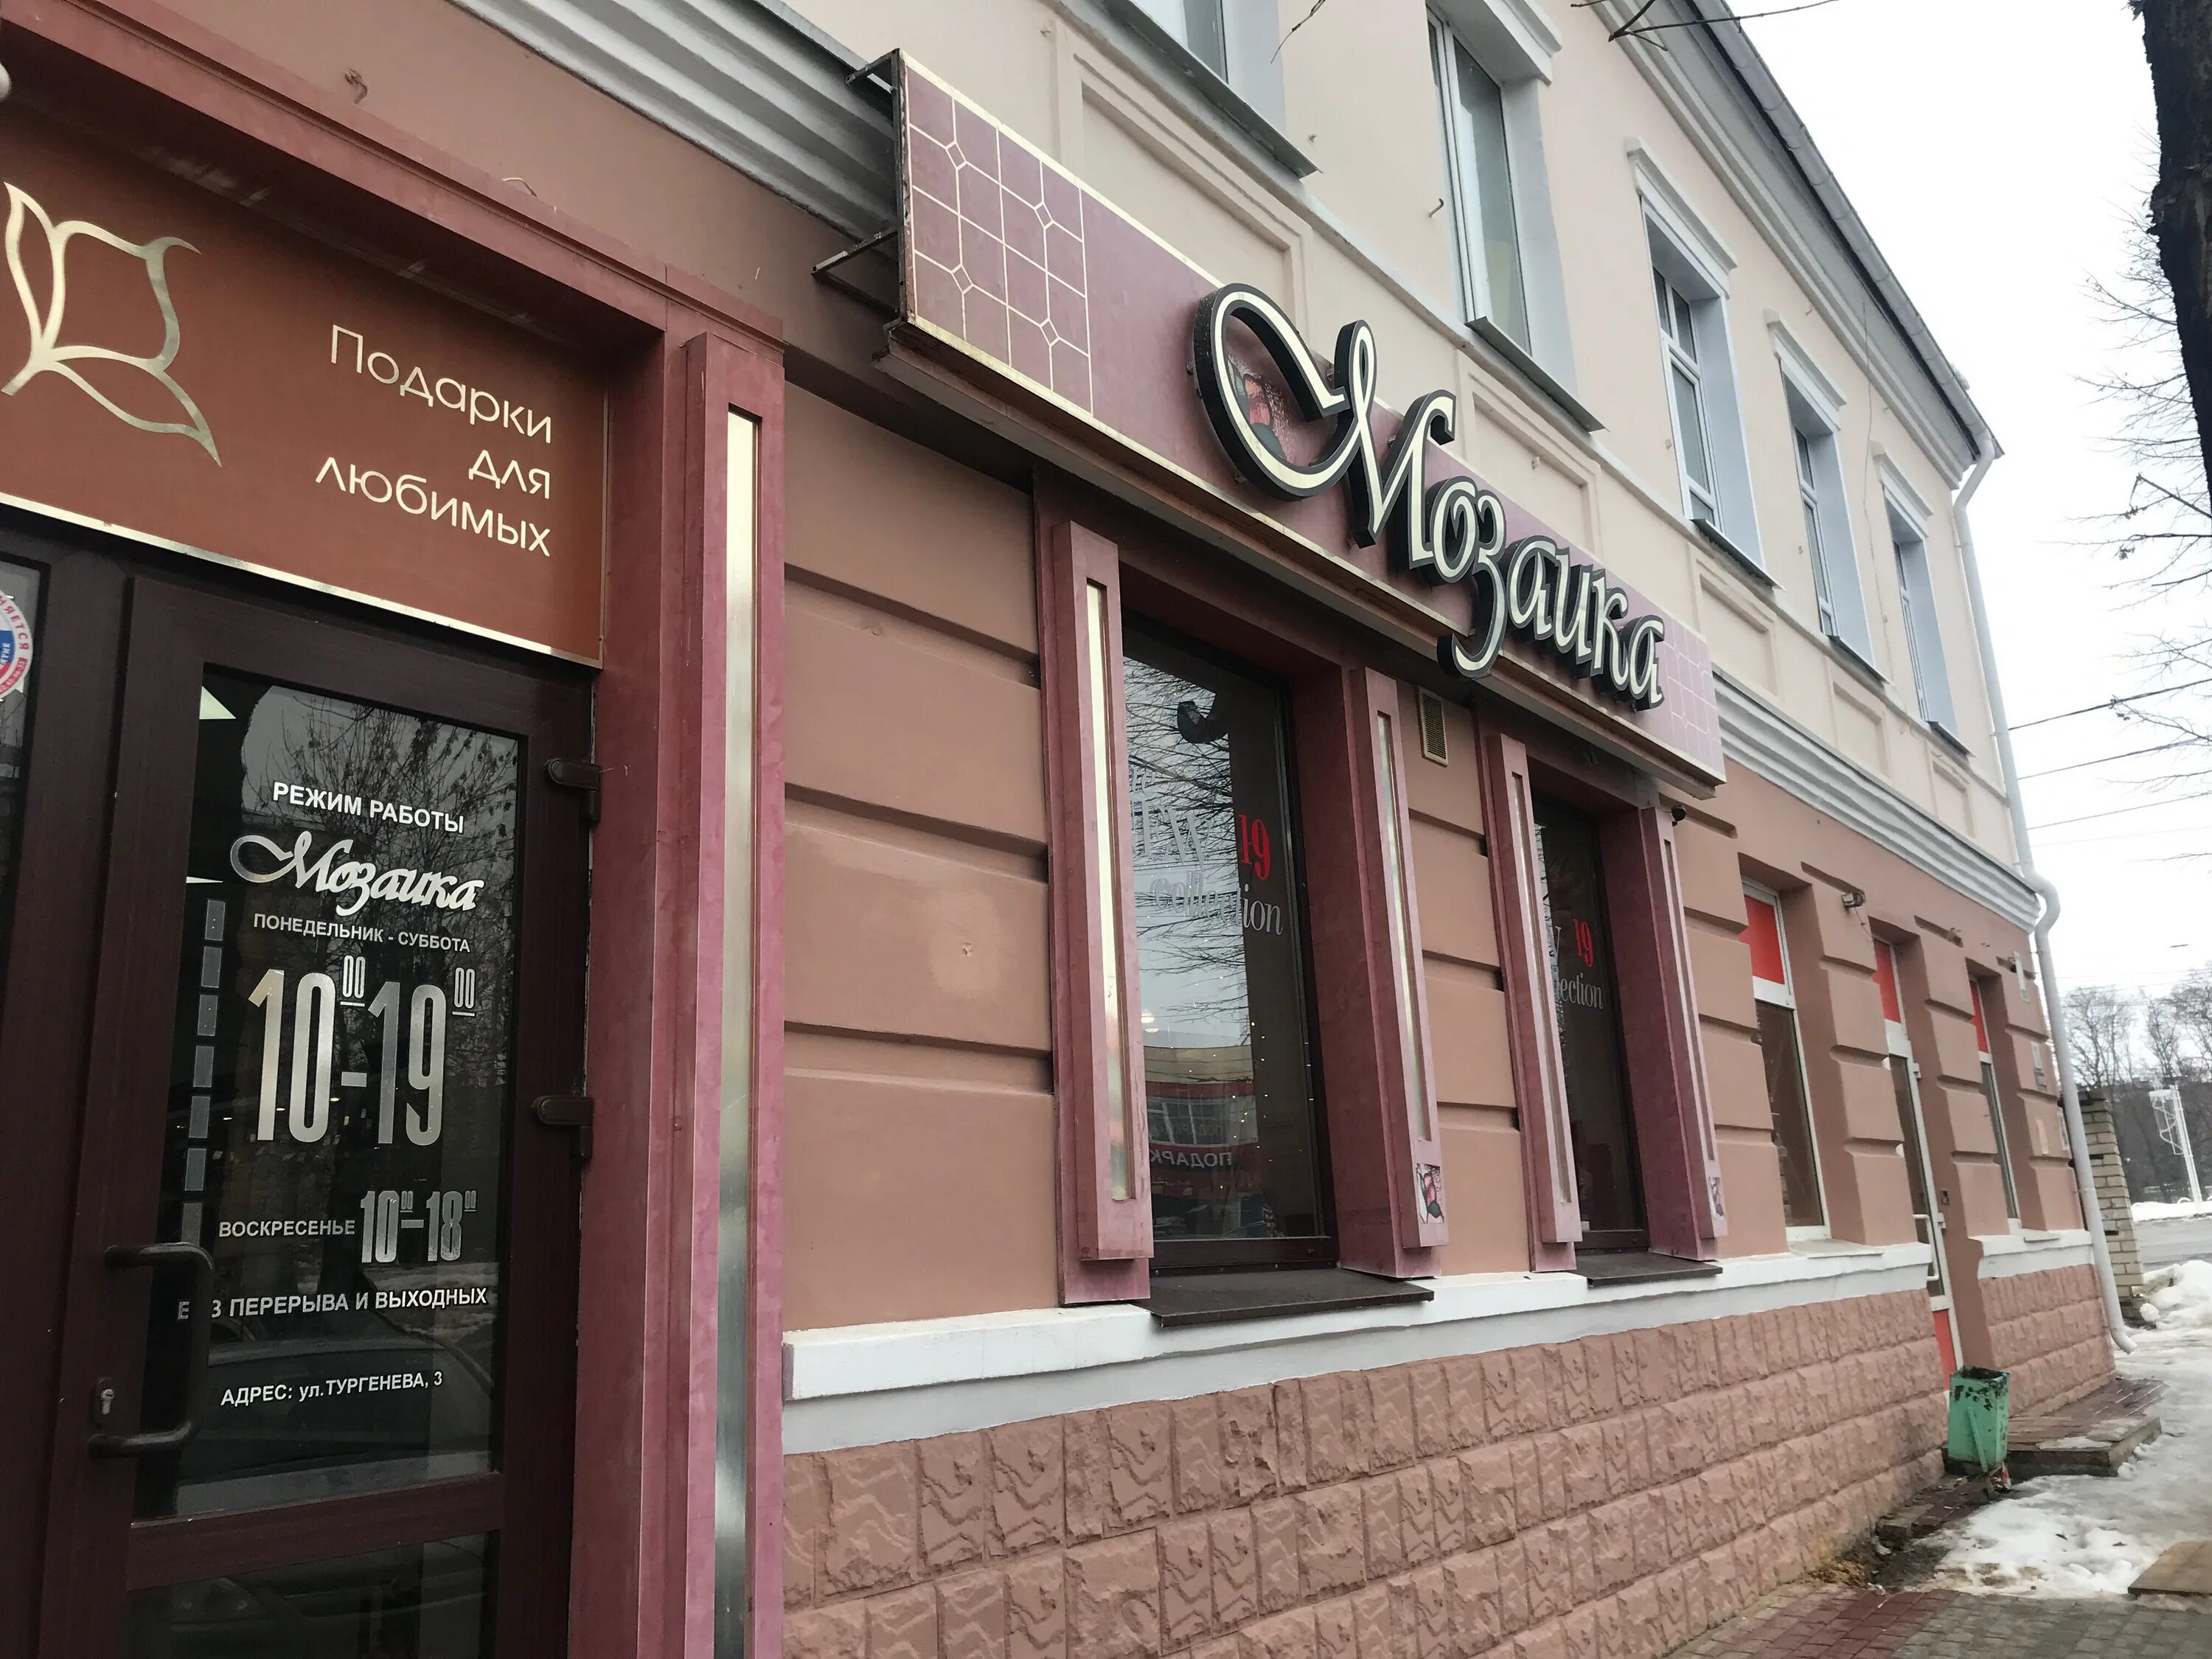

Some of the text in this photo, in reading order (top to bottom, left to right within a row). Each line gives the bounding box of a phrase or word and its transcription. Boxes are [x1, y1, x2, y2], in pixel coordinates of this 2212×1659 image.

[331, 324, 552, 445] Подарки
[467, 449, 551, 499] для
[1194, 282, 1665, 712] Мозаика
[315, 456, 552, 557] любимых
[272, 781, 465, 835] РЕЖИМ РАБОТЫ
[230, 830, 484, 917] Мозаика
[1239, 814, 1272, 881] 19
[253, 912, 383, 943] ПОНЕДЕЛЬНИК
[397, 931, 471, 953] СУББОТА
[1572, 919, 1594, 968] 19
[218, 1220, 355, 1239] ВОСКРЕСЕНЬЕ
[229, 1293, 349, 1318] ПЕРЕРЫВА
[355, 1292, 369, 1310] И
[375, 1287, 487, 1310] ВЫХОДНЫХ
[220, 1383, 293, 1408] АДРЕС:
[433, 1371, 443, 1386] 3
